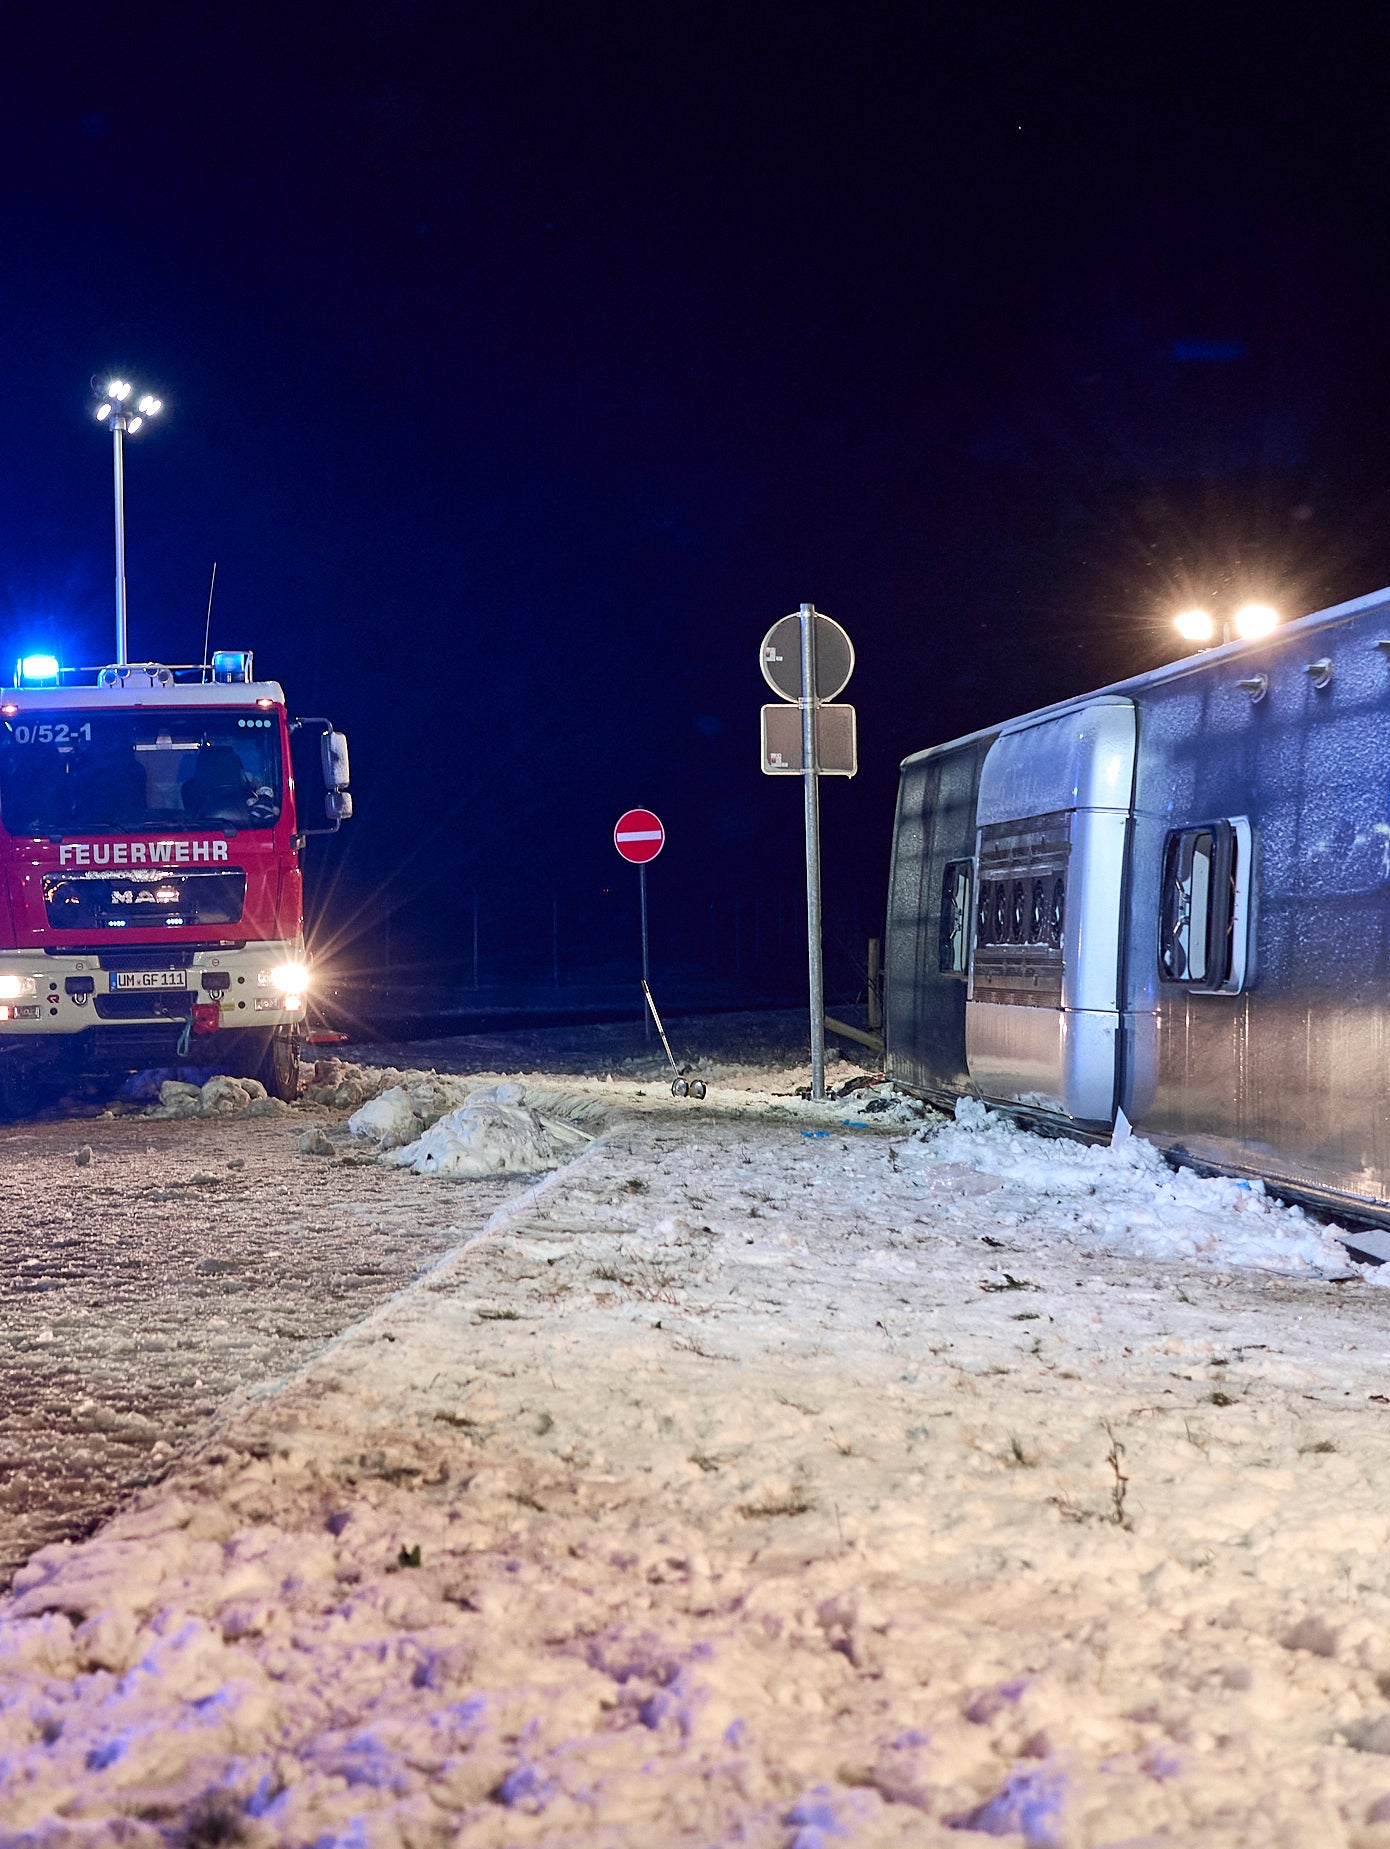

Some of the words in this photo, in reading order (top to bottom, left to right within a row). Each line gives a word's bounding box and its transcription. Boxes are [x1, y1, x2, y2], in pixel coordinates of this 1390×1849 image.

[15, 723, 91, 744] 0/52-1
[59, 840, 229, 865] FEUERWEHR
[118, 974, 135, 987] UM
[142, 973, 159, 986] GF
[161, 973, 184, 985] 111
